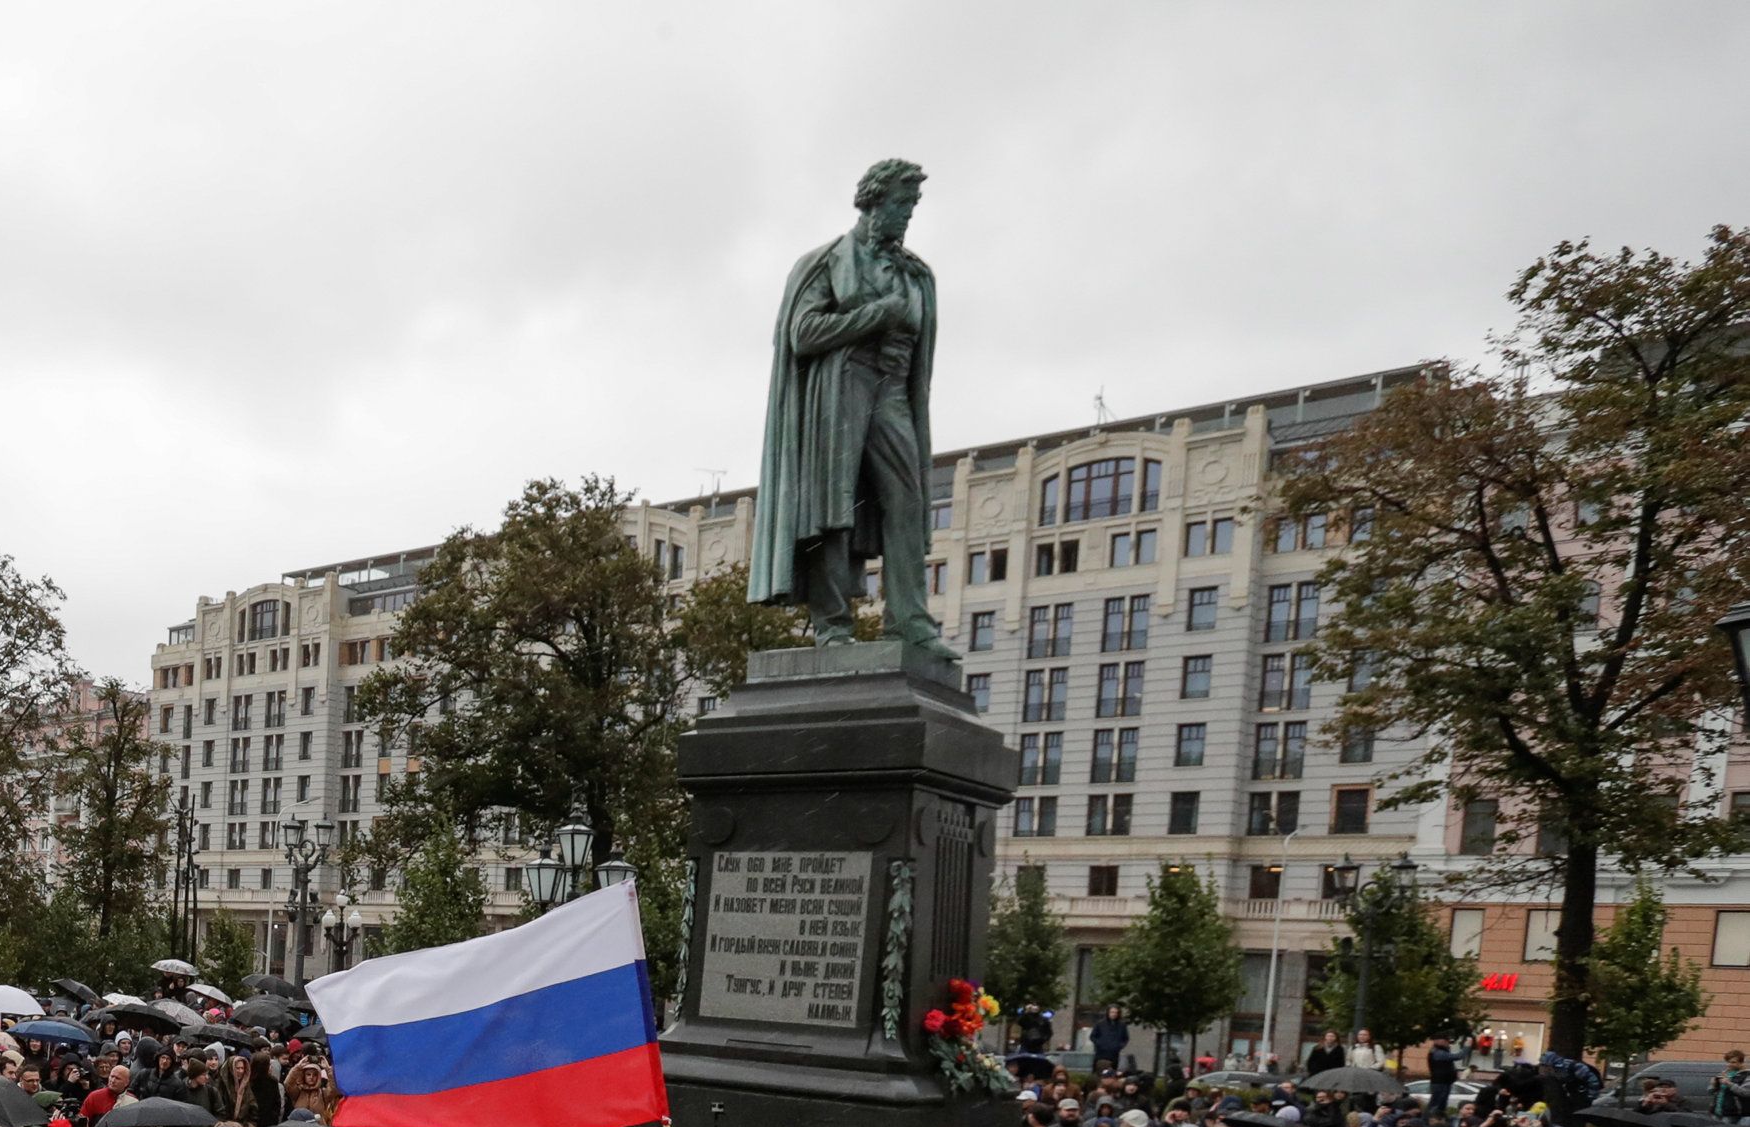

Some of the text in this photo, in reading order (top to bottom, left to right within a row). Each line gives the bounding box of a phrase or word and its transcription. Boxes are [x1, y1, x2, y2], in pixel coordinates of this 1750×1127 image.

[747, 857, 765, 873] ОБО
[772, 857, 793, 873] МНЕ
[799, 854, 846, 875] ПРОЙДЕТ
[746, 877, 758, 893] ПО
[762, 874, 787, 893] ВСЕЙ
[713, 894, 863, 917] И НАЗОВЕТ МЕНЯ ВСЯК СУЩИЙ
[799, 920, 806, 936] В
[809, 917, 828, 936] НЕЙ
[710, 935, 718, 952] И
[718, 936, 756, 955] ГОРДЫЙ
[756, 938, 781, 955] ВНУК
[779, 960, 786, 976] И
[791, 961, 819, 978] НЫНЕ
[768, 980, 775, 995] И
[781, 981, 807, 998] ДРУГ
[813, 979, 854, 1000] СТЕПЕЙ
